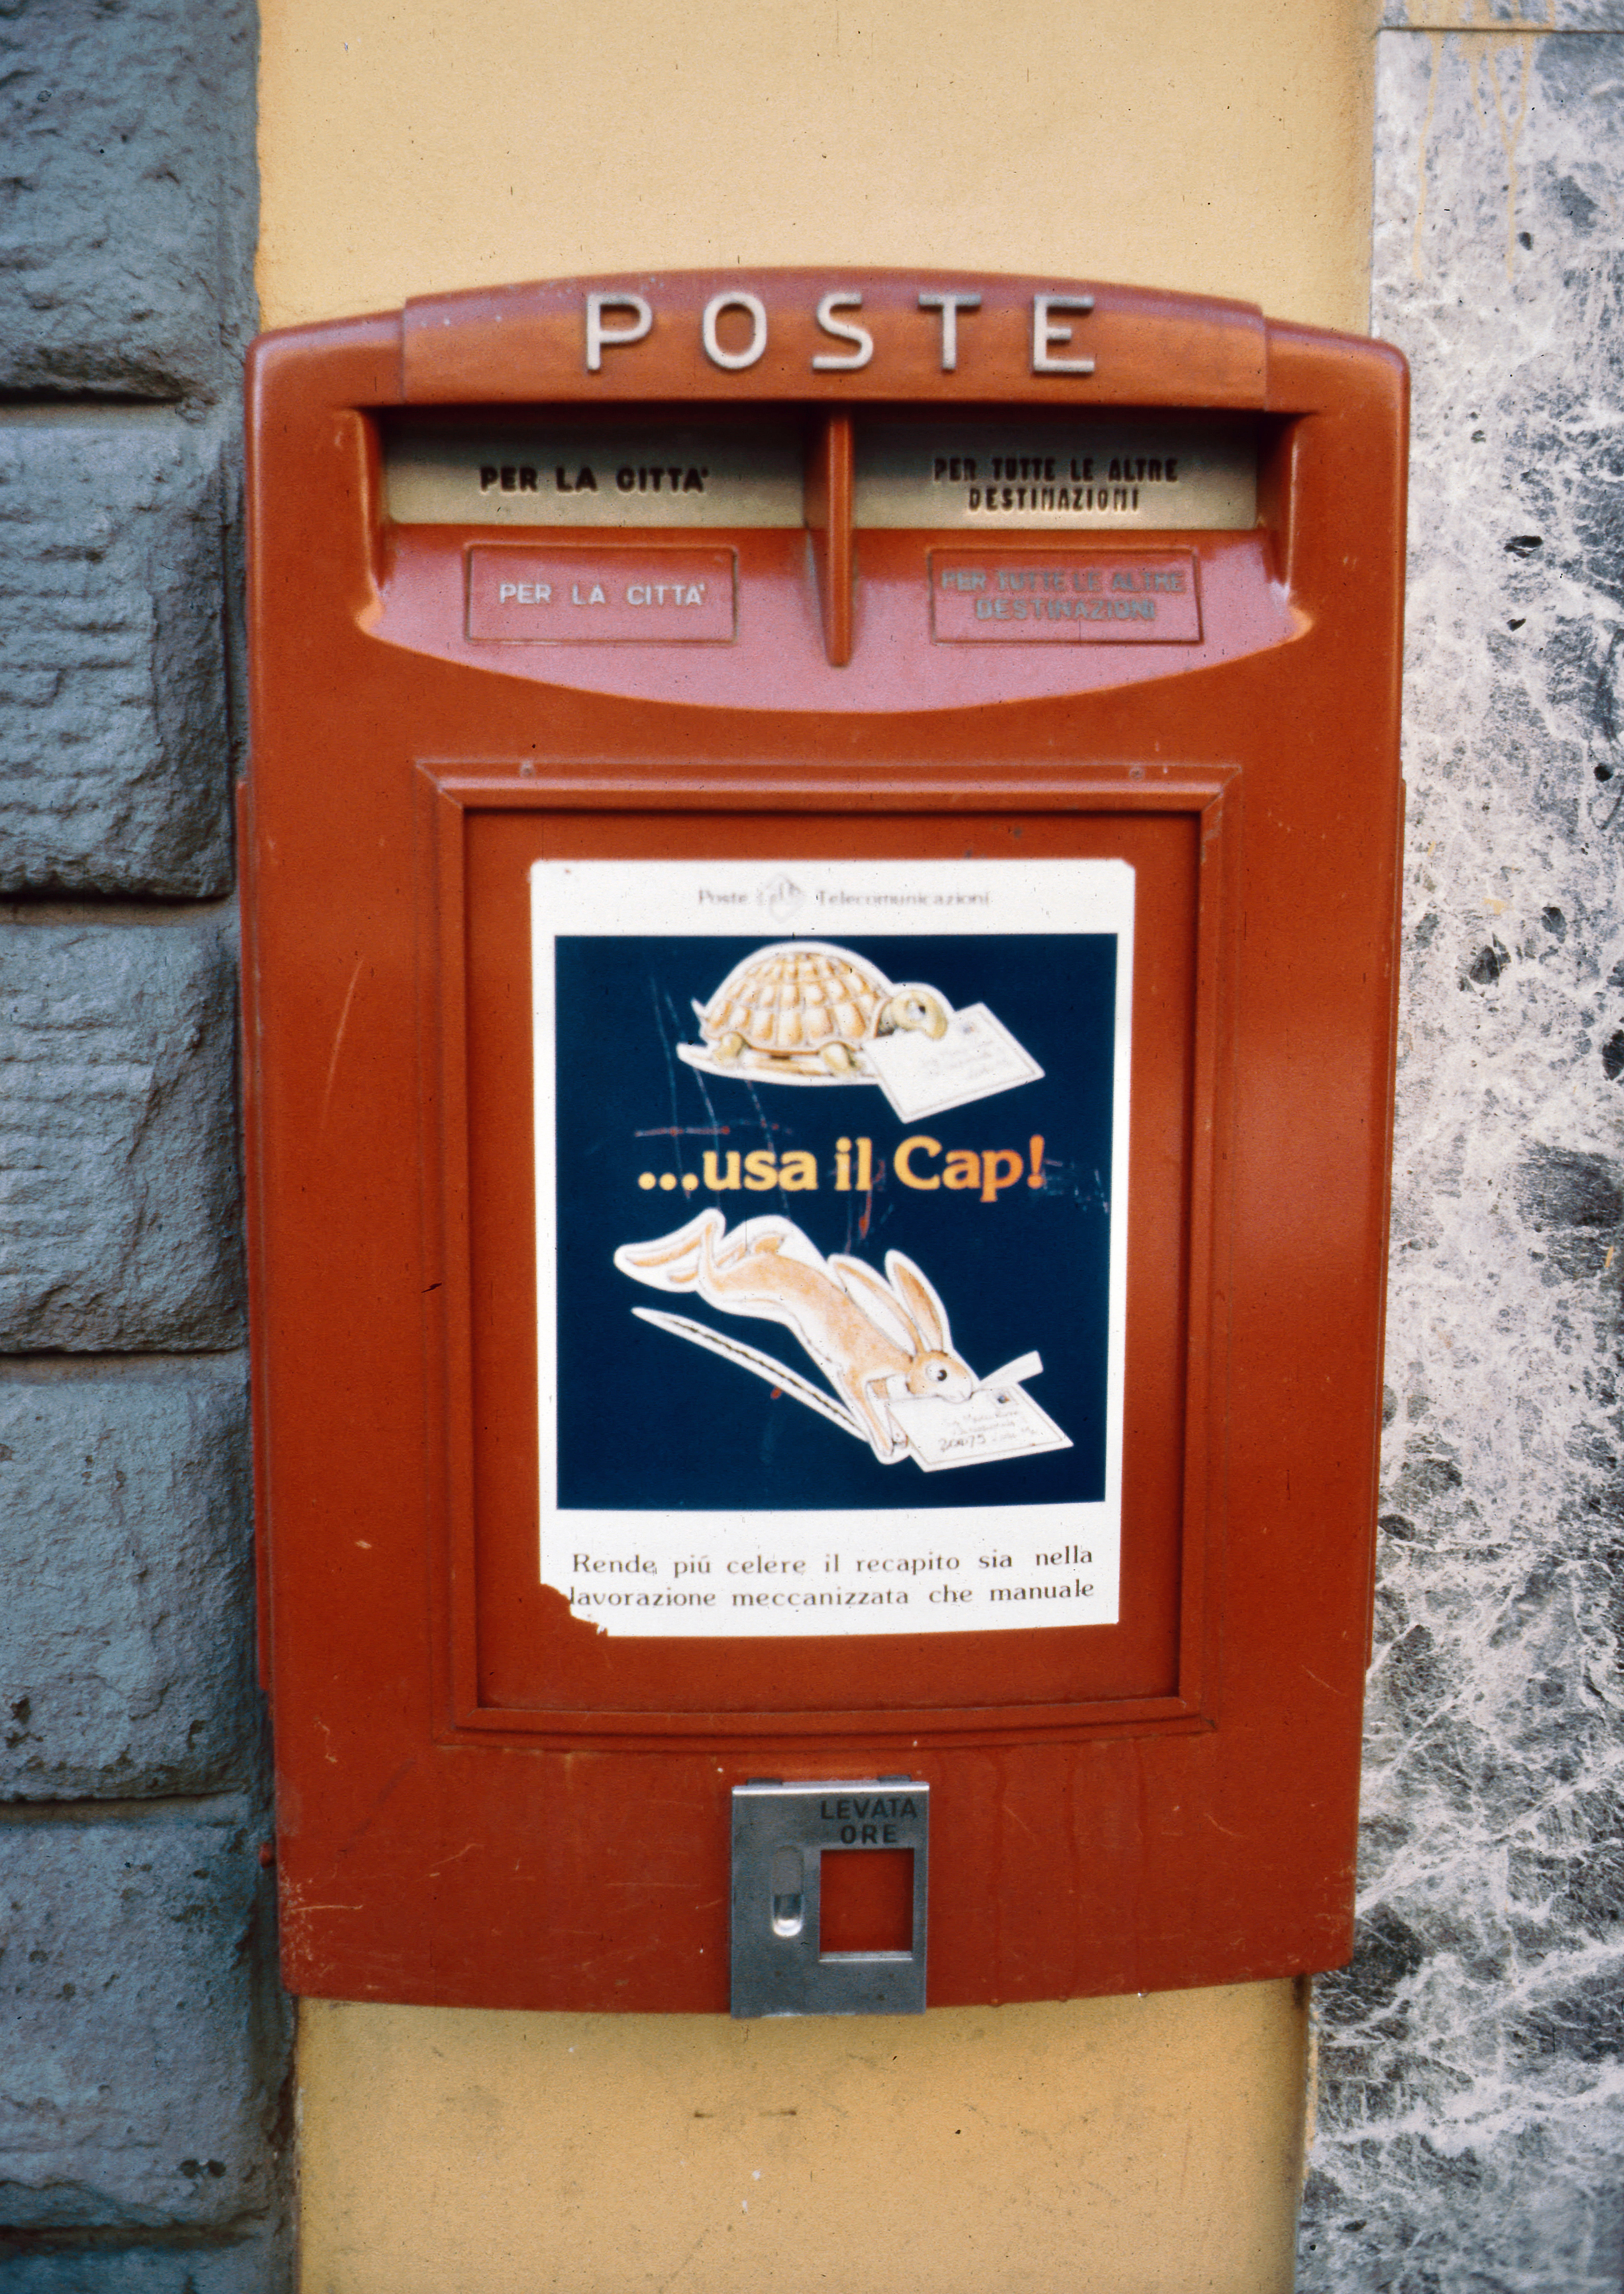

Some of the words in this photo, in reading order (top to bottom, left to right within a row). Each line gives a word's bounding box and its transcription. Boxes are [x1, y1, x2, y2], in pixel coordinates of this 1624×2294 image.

[586, 293, 1096, 373] POSTE
[480, 466, 538, 492] PER
[556, 466, 597, 492] LA
[932, 457, 976, 482] PER
[991, 457, 1056, 482] TUTTE
[1069, 458, 1093, 482] LE
[1108, 458, 1178, 482] ALTRE
[968, 487, 1140, 511] DESTINAZIONI
[941, 570, 986, 592] PER
[998, 570, 1066, 592] TUTTE
[1073, 570, 1102, 592] LE
[1111, 571, 1186, 593] ALTRE
[499, 583, 552, 605] PER
[571, 584, 606, 606] LA
[975, 598, 1156, 620] DESTINAZIONI
[698, 888, 748, 905] Poste
[835, 1137, 872, 1191] il
[893, 1134, 1045, 1203] Cap!
[573, 1553, 656, 1573] Rende
[727, 1555, 806, 1574] celere
[825, 1553, 839, 1573] il
[856, 1551, 960, 1575] recapito
[978, 1549, 1013, 1569] sia
[1035, 1545, 1092, 1566] nella
[569, 1586, 715, 1606] lavorazione
[732, 1586, 909, 1606] meccanizzata
[928, 1584, 973, 1603] che
[990, 1578, 1094, 1602] manuale
[820, 1798, 917, 1820] LEVATA
[840, 1823, 898, 1844] ORE
